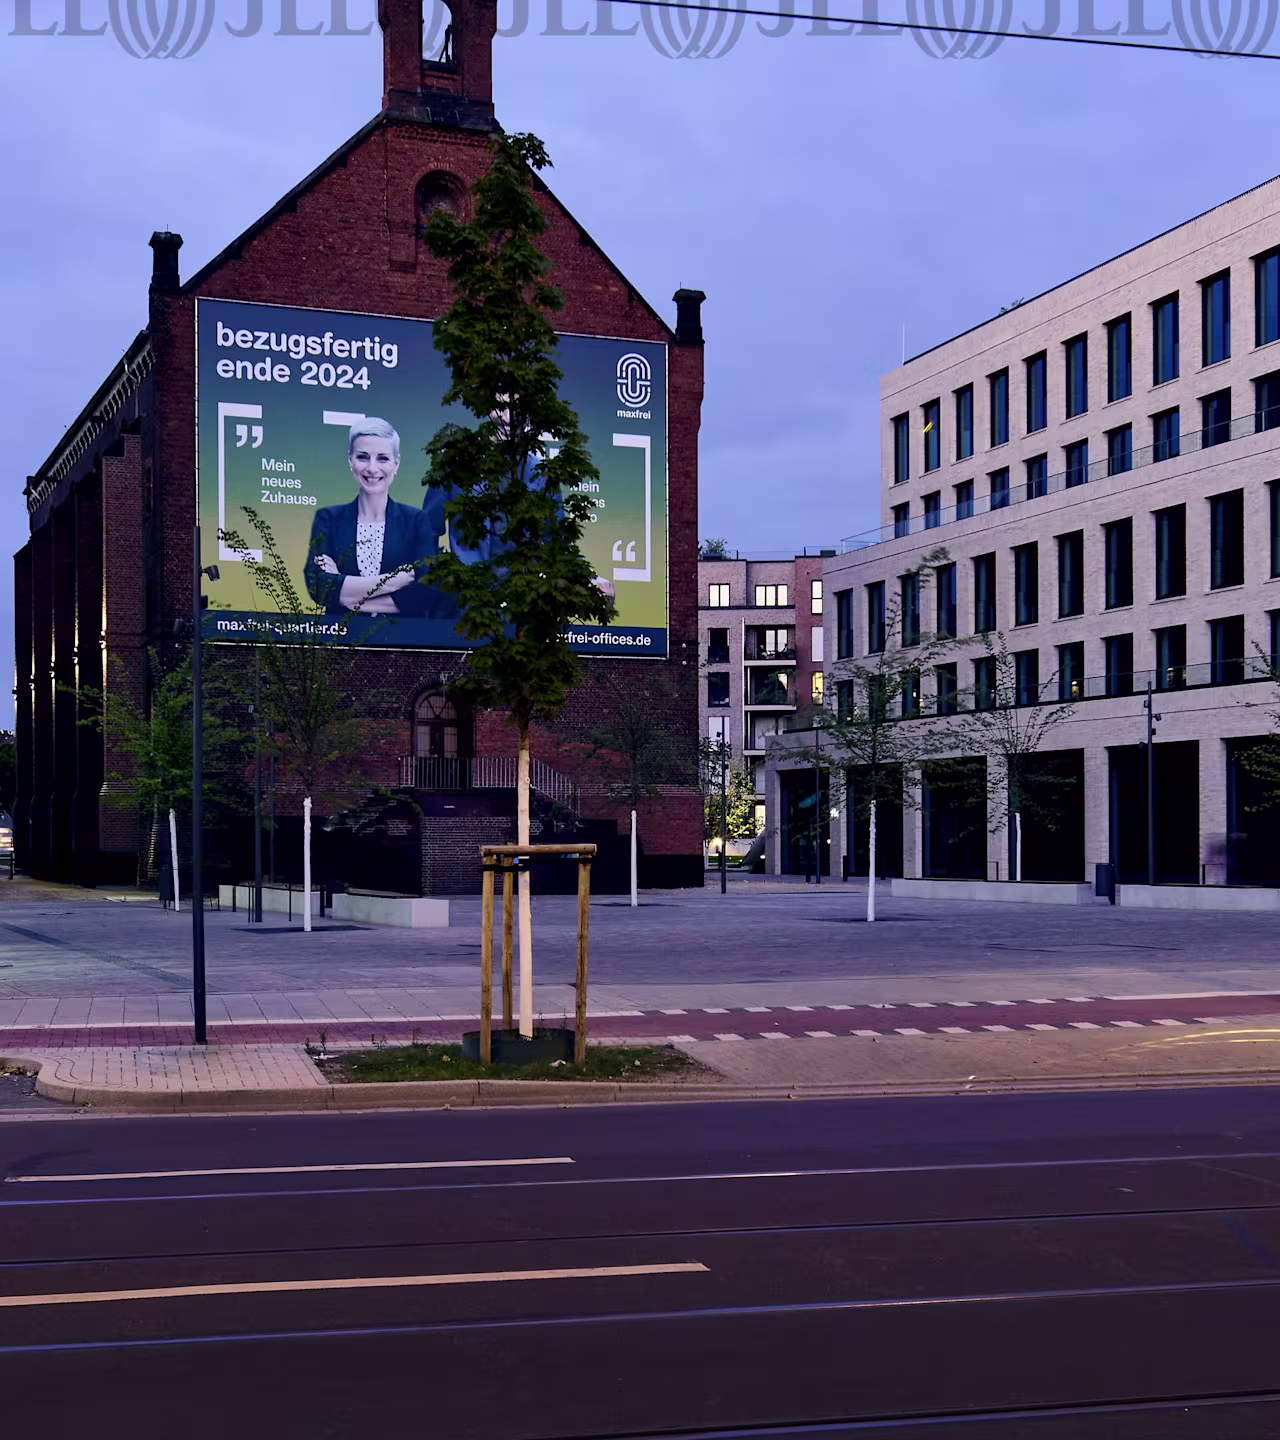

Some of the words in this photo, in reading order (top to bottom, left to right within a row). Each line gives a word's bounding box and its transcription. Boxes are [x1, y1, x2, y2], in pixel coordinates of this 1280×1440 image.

[216, 321, 398, 368] bezugsfertig
[216, 357, 290, 383] ende
[300, 361, 371, 390] 2024
[616, 409, 651, 420] maxfrei
[261, 458, 295, 472] Mein
[261, 476, 302, 489] neues
[261, 490, 317, 506] Zuhause
[547, 630, 651, 646] frei-offices.de
